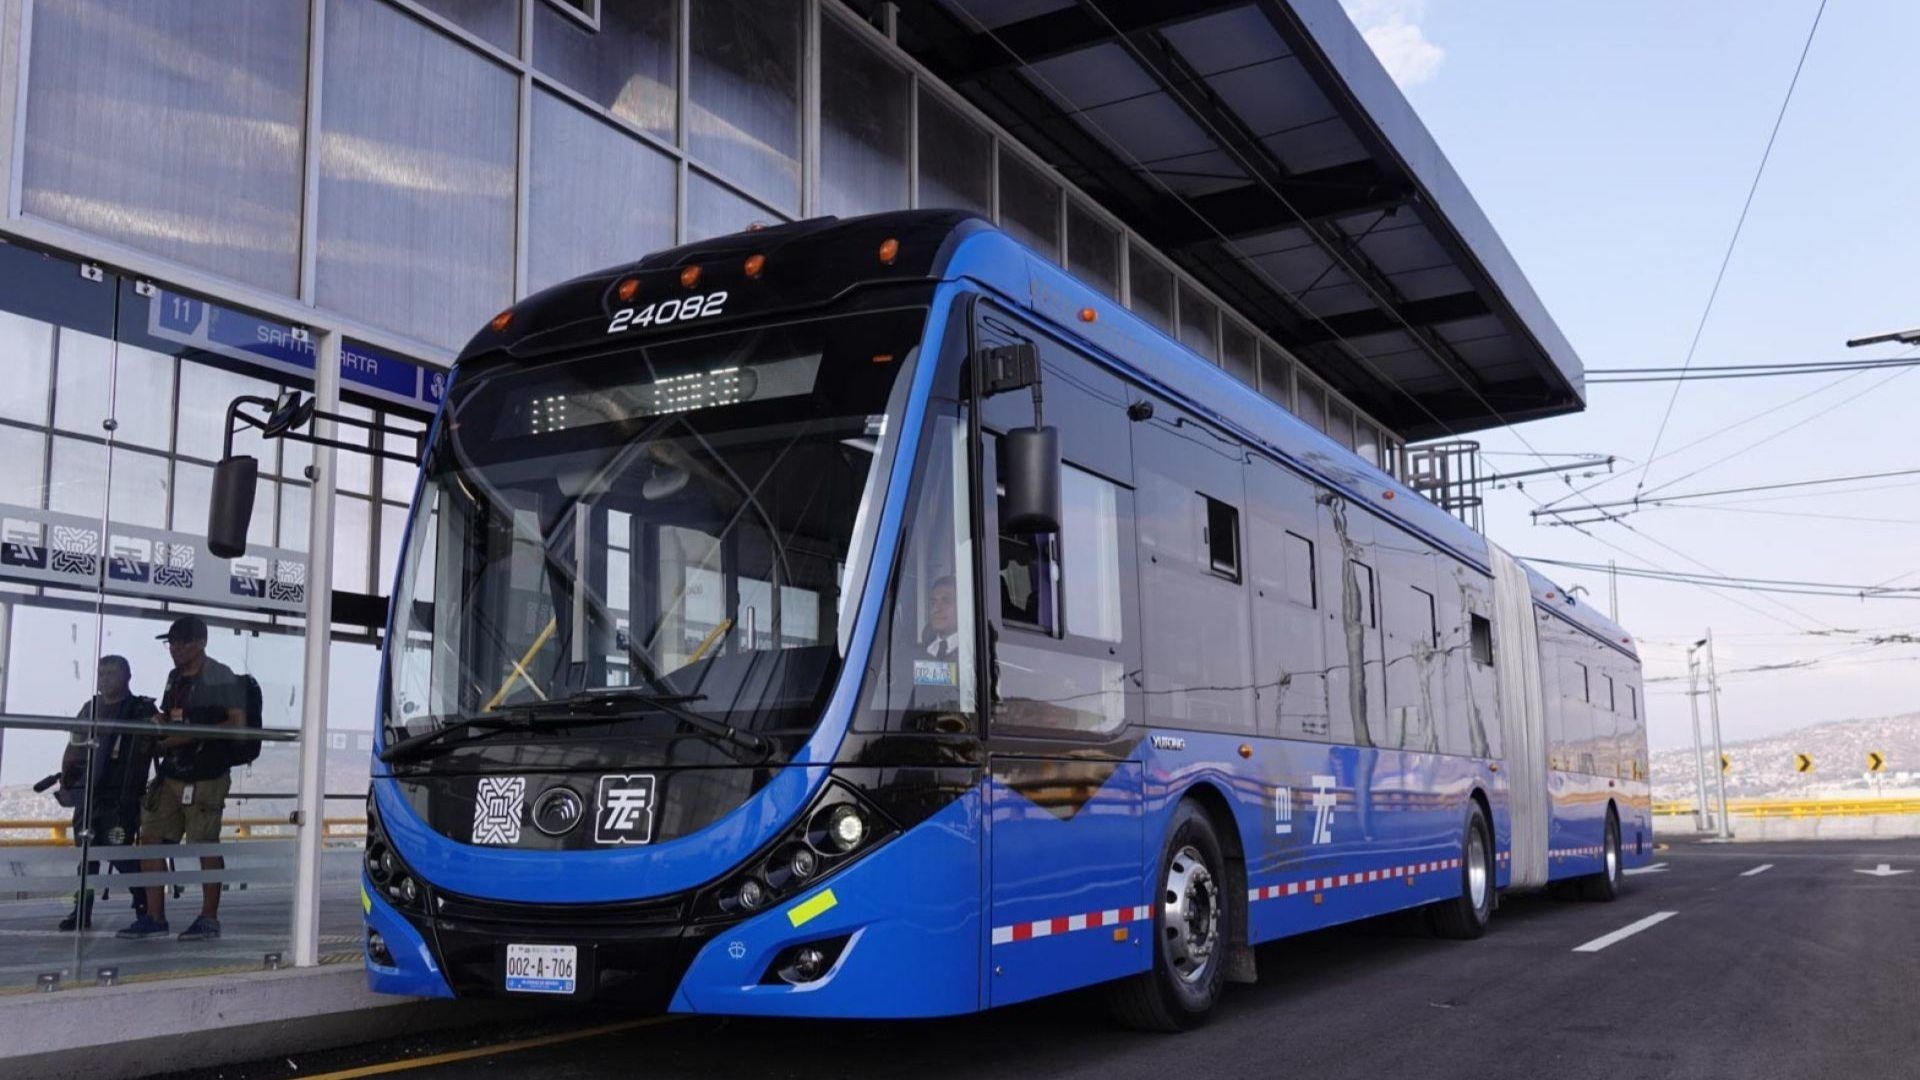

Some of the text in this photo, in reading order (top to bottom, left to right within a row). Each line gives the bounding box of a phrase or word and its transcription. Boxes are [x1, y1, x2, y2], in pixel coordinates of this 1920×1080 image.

[607, 291, 728, 334] 24082
[172, 297, 191, 323] 11
[340, 350, 378, 376] ARTA
[508, 957, 573, 978] 002-A-706
